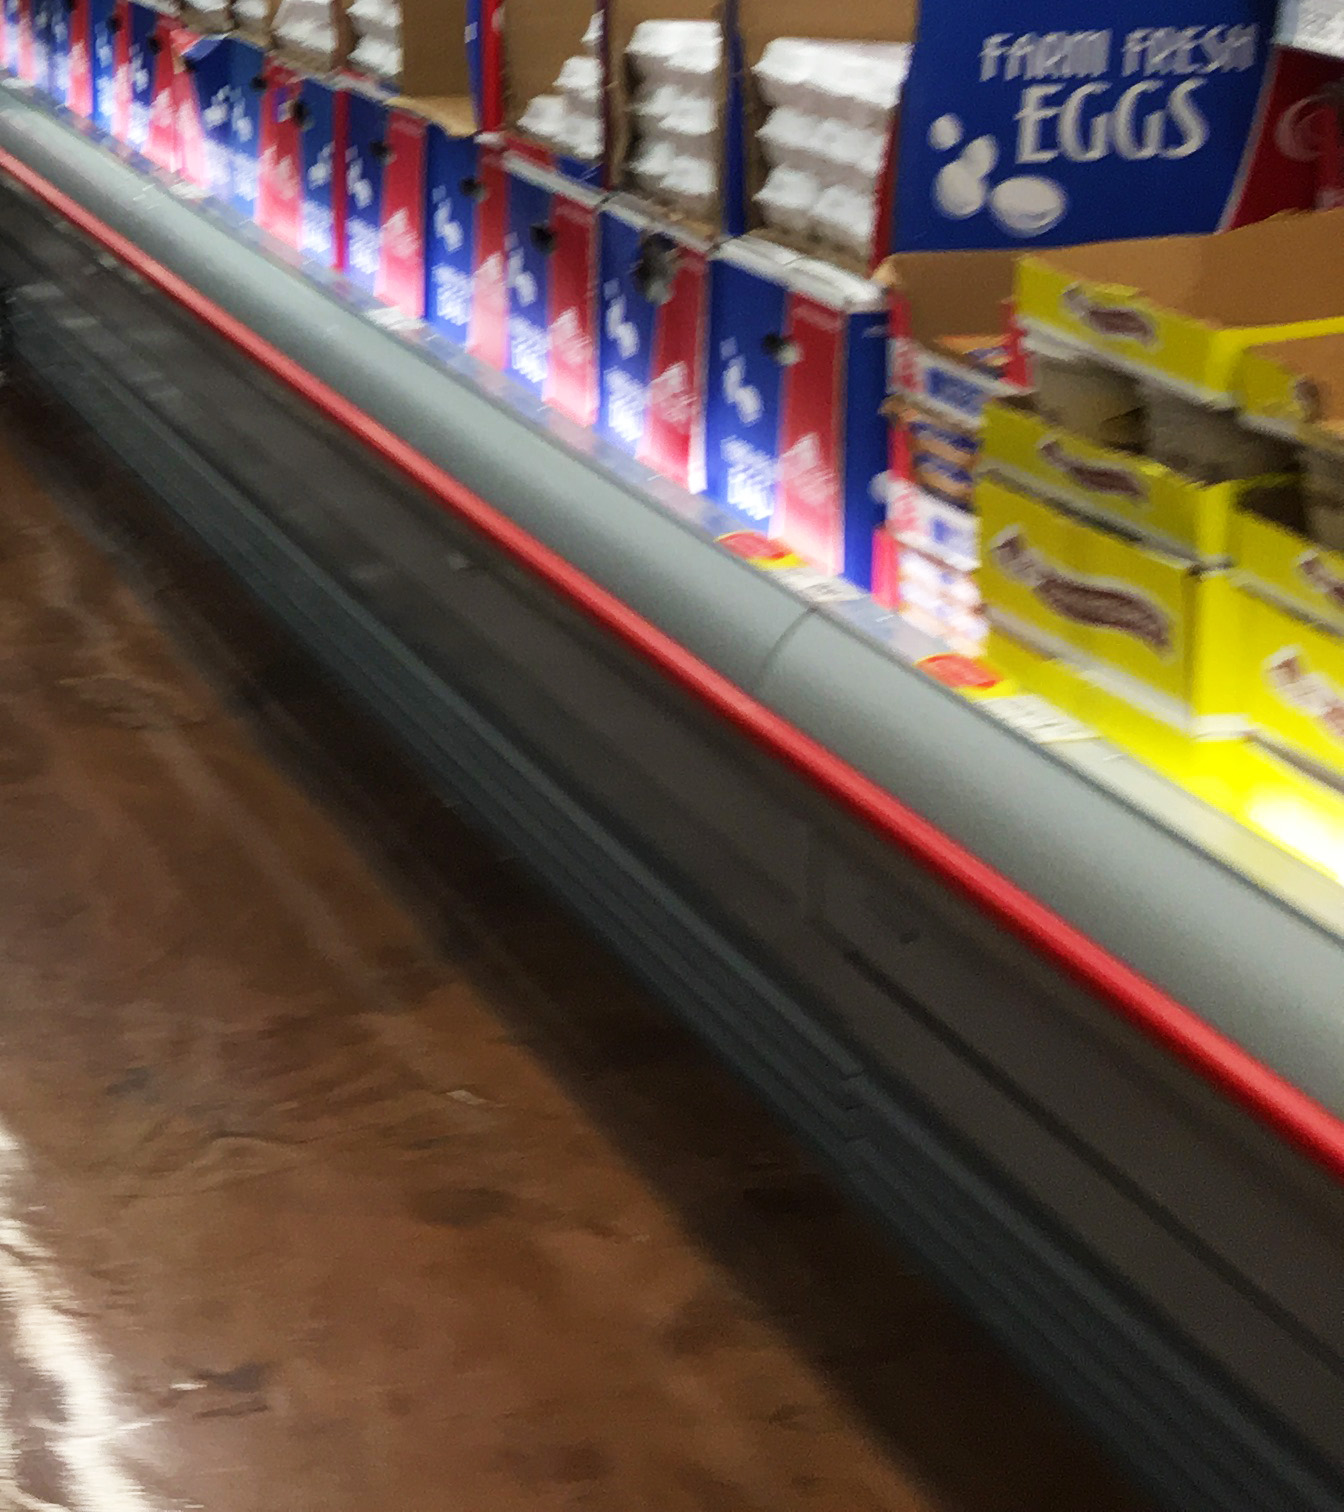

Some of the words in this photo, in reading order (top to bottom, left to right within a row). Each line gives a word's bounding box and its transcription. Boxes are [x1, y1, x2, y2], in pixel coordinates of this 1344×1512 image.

[980, 28, 1112, 82] FARM
[1120, 23, 1260, 78] FRESH
[1014, 77, 1209, 165] EGGS
